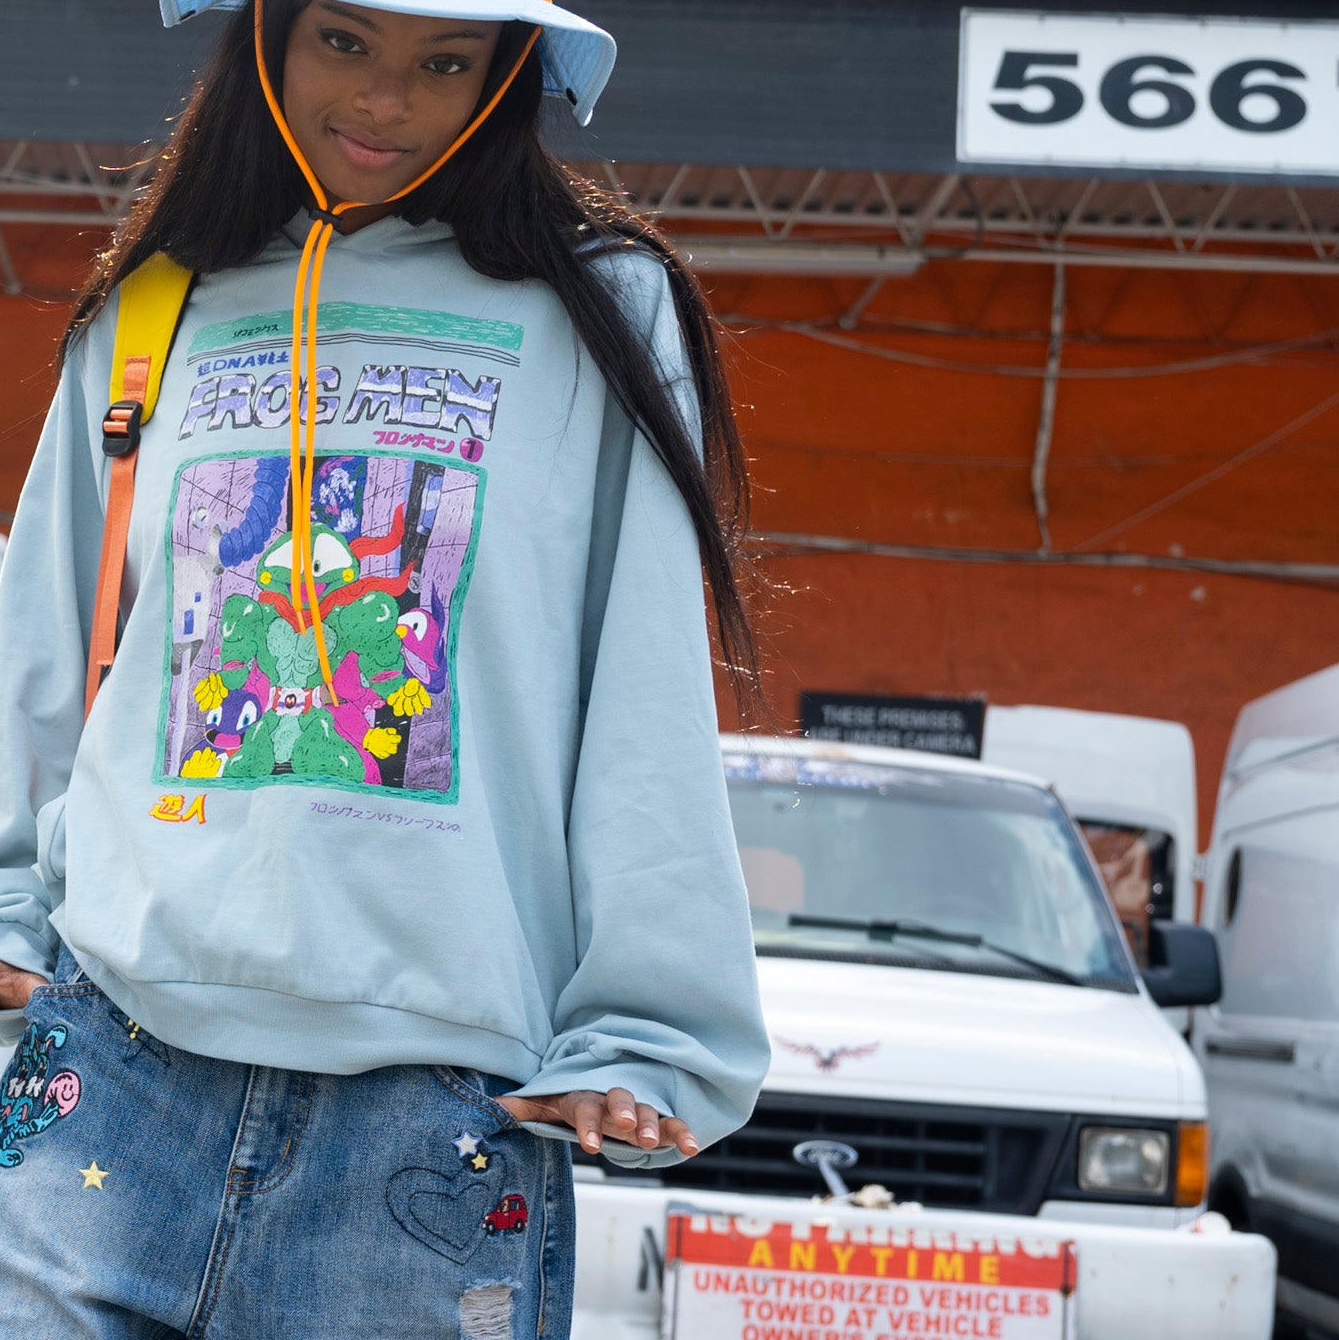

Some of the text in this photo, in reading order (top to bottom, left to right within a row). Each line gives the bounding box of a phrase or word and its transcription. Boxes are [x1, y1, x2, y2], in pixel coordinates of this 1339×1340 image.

[989, 51, 1339, 134] 566
[179, 364, 502, 441] FROG MEN
[748, 1240, 1001, 1285] ANYTIME
[693, 1270, 1050, 1318] UNAUTHORIZED VEHICLES
[740, 1298, 1002, 1339] TOWED AT VEHICLE
